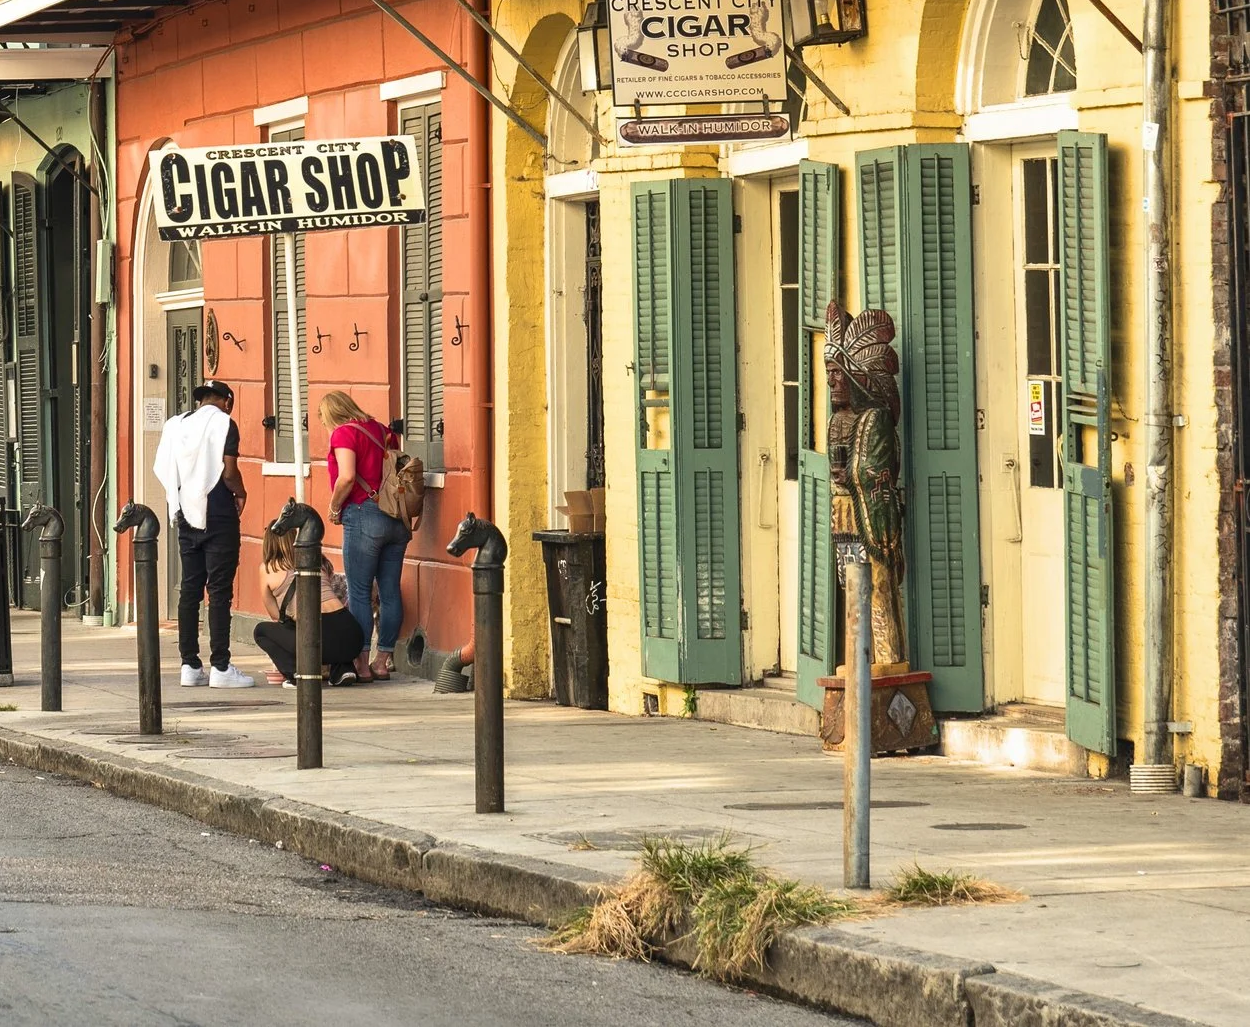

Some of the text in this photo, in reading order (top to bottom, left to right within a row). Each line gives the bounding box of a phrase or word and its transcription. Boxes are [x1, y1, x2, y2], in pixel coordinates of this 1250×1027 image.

[641, 14, 751, 39] CIGAR
[667, 43, 729, 58] SHOP
[616, 76, 647, 84] RETAILER
[636, 87, 764, 99] WWW.CCCIGARSHOP.COM
[638, 120, 771, 136] WALK-IN HUMIDOR
[205, 141, 361, 161] CRESCENT CITY
[160, 140, 410, 224] CIGAR SHOP
[176, 212, 410, 239] WALK-IN HUMIDOR
